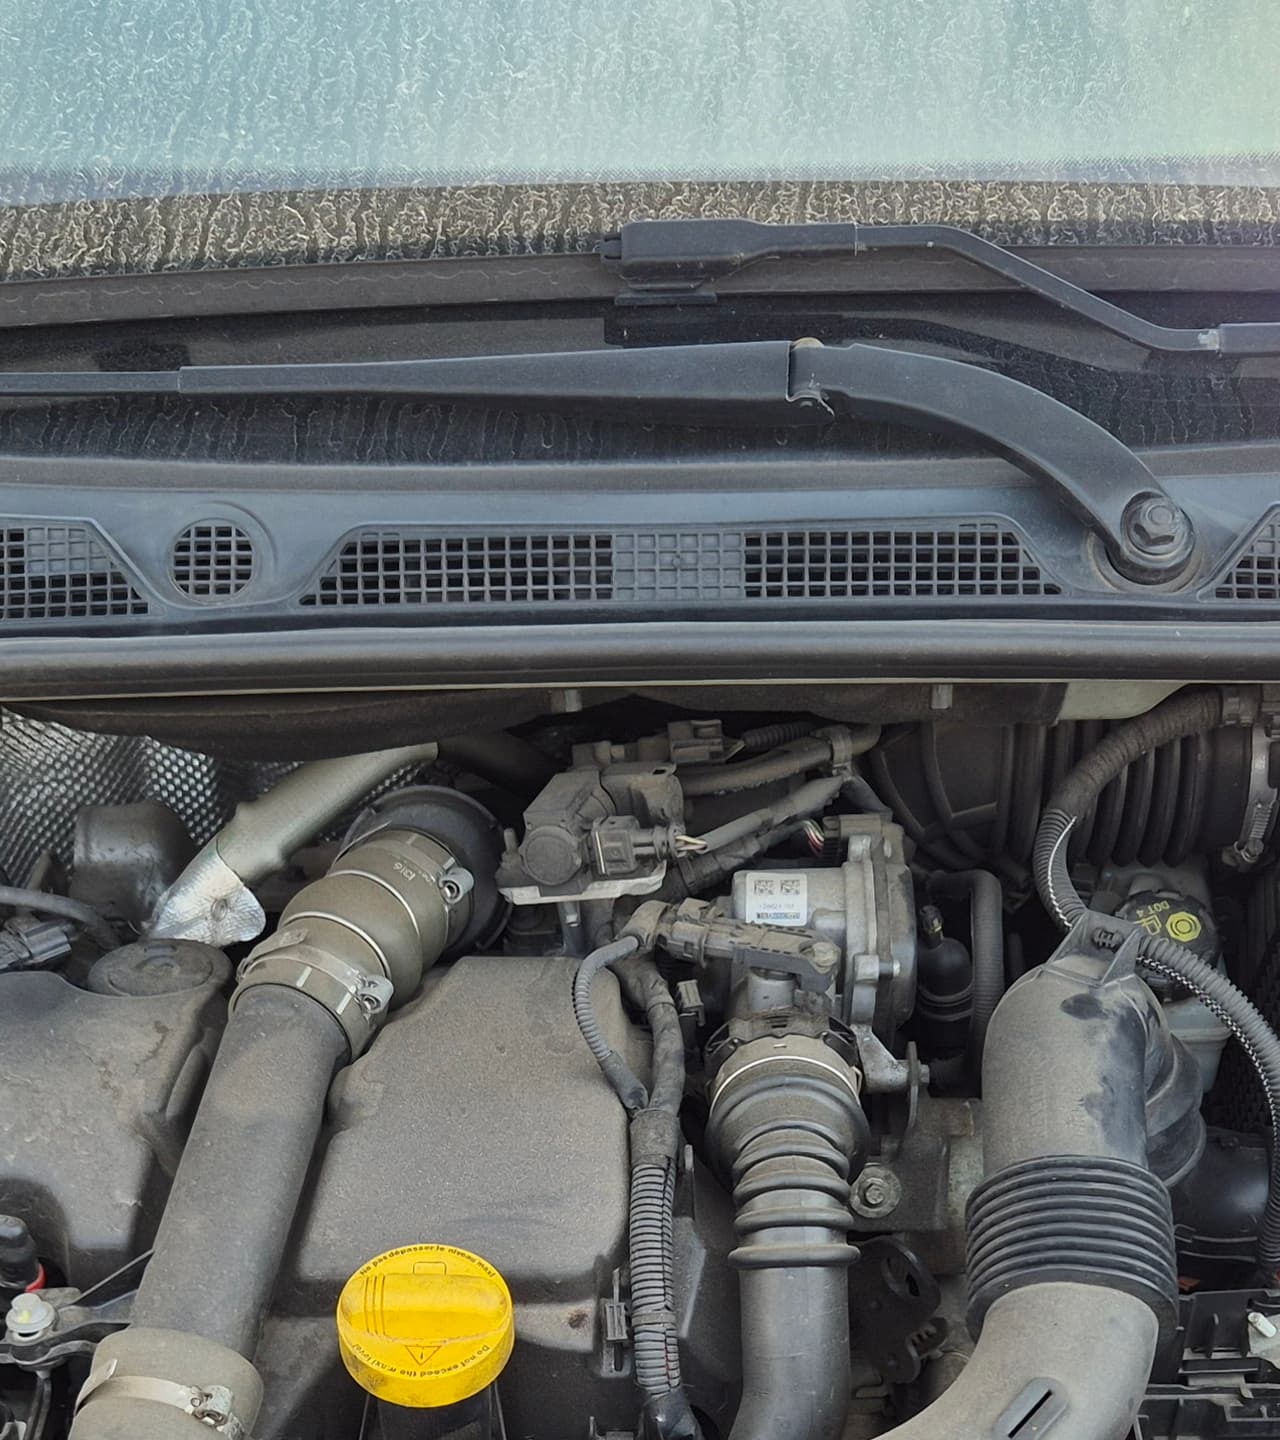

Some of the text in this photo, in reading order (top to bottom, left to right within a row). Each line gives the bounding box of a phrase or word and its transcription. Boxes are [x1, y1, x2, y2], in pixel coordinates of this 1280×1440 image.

[1147, 899, 1171, 915] DOT
[372, 1254, 388, 1269] pas
[435, 1244, 446, 1253] le
[447, 1247, 477, 1264] niveau
[476, 1345, 491, 1357] Do
[460, 1354, 478, 1369] not
[399, 1368, 418, 1379] the
[418, 1363, 461, 1379] exceed
